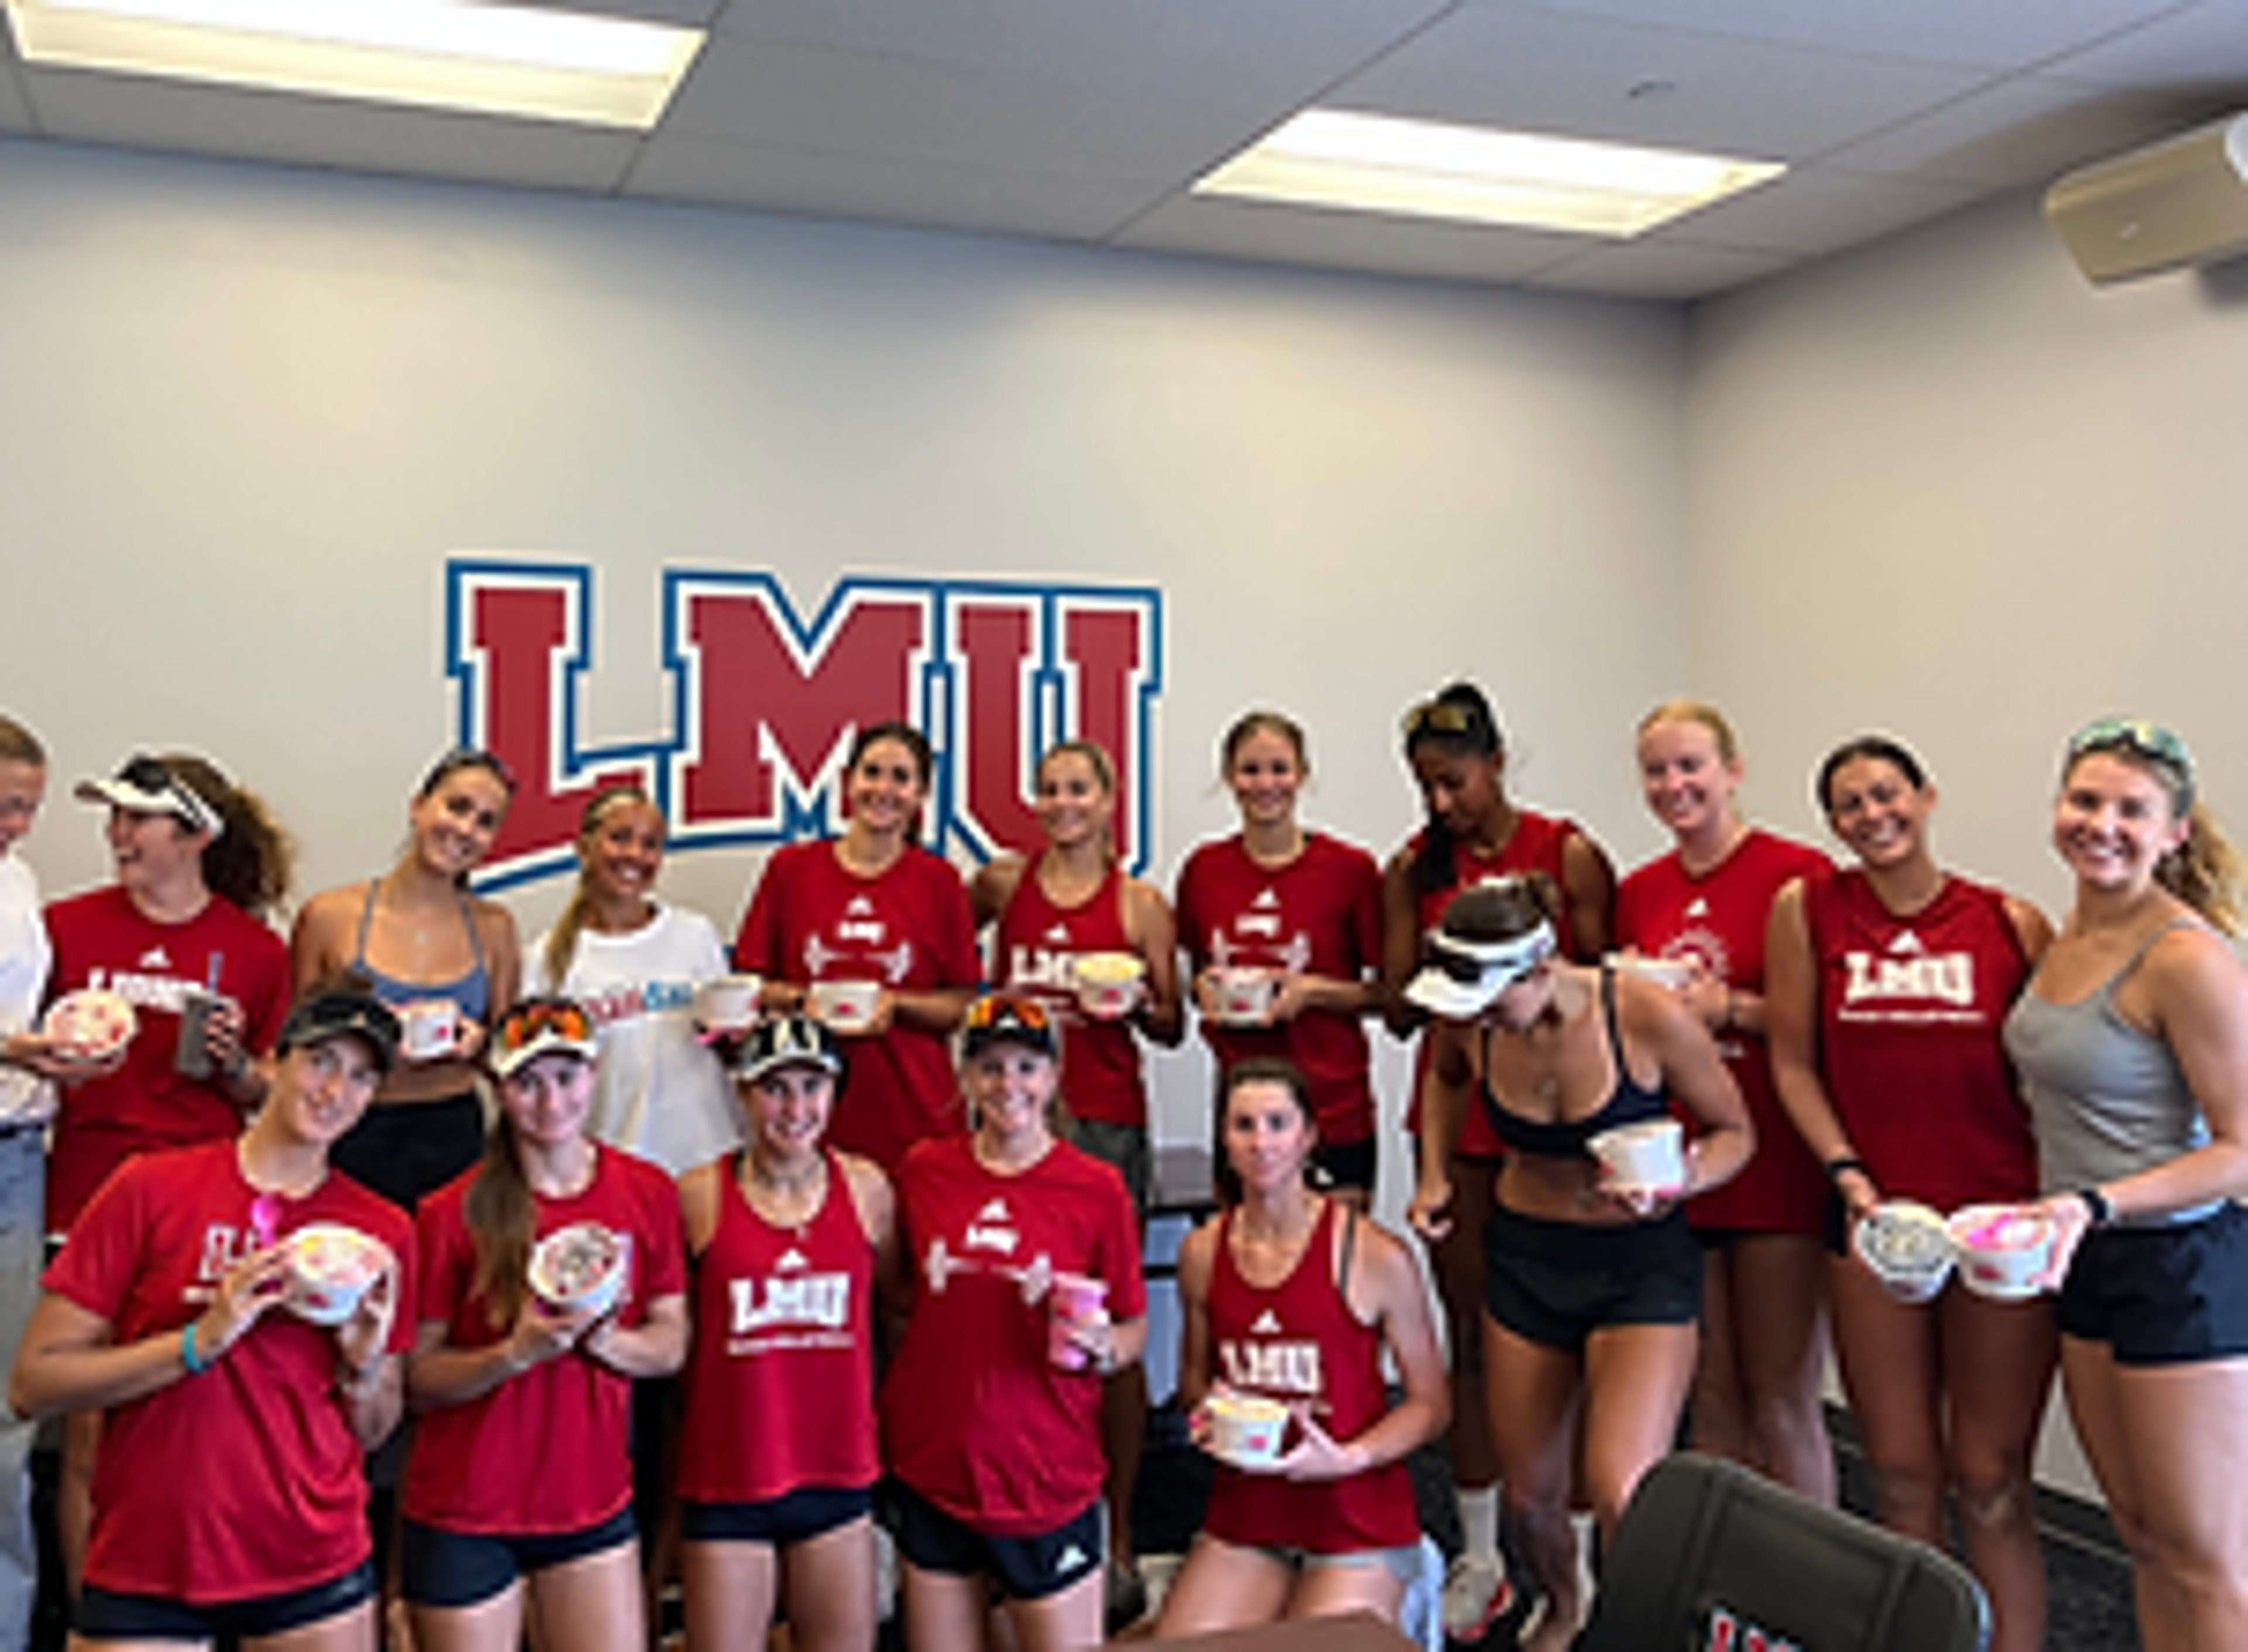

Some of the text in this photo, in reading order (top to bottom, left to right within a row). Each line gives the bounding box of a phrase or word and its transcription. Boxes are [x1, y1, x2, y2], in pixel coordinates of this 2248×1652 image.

[448, 558, 1162, 893] LMU
[1844, 951, 1974, 1007] LMU
[728, 1273, 850, 1334] LMU
[1219, 1339, 1322, 1393] LMU
